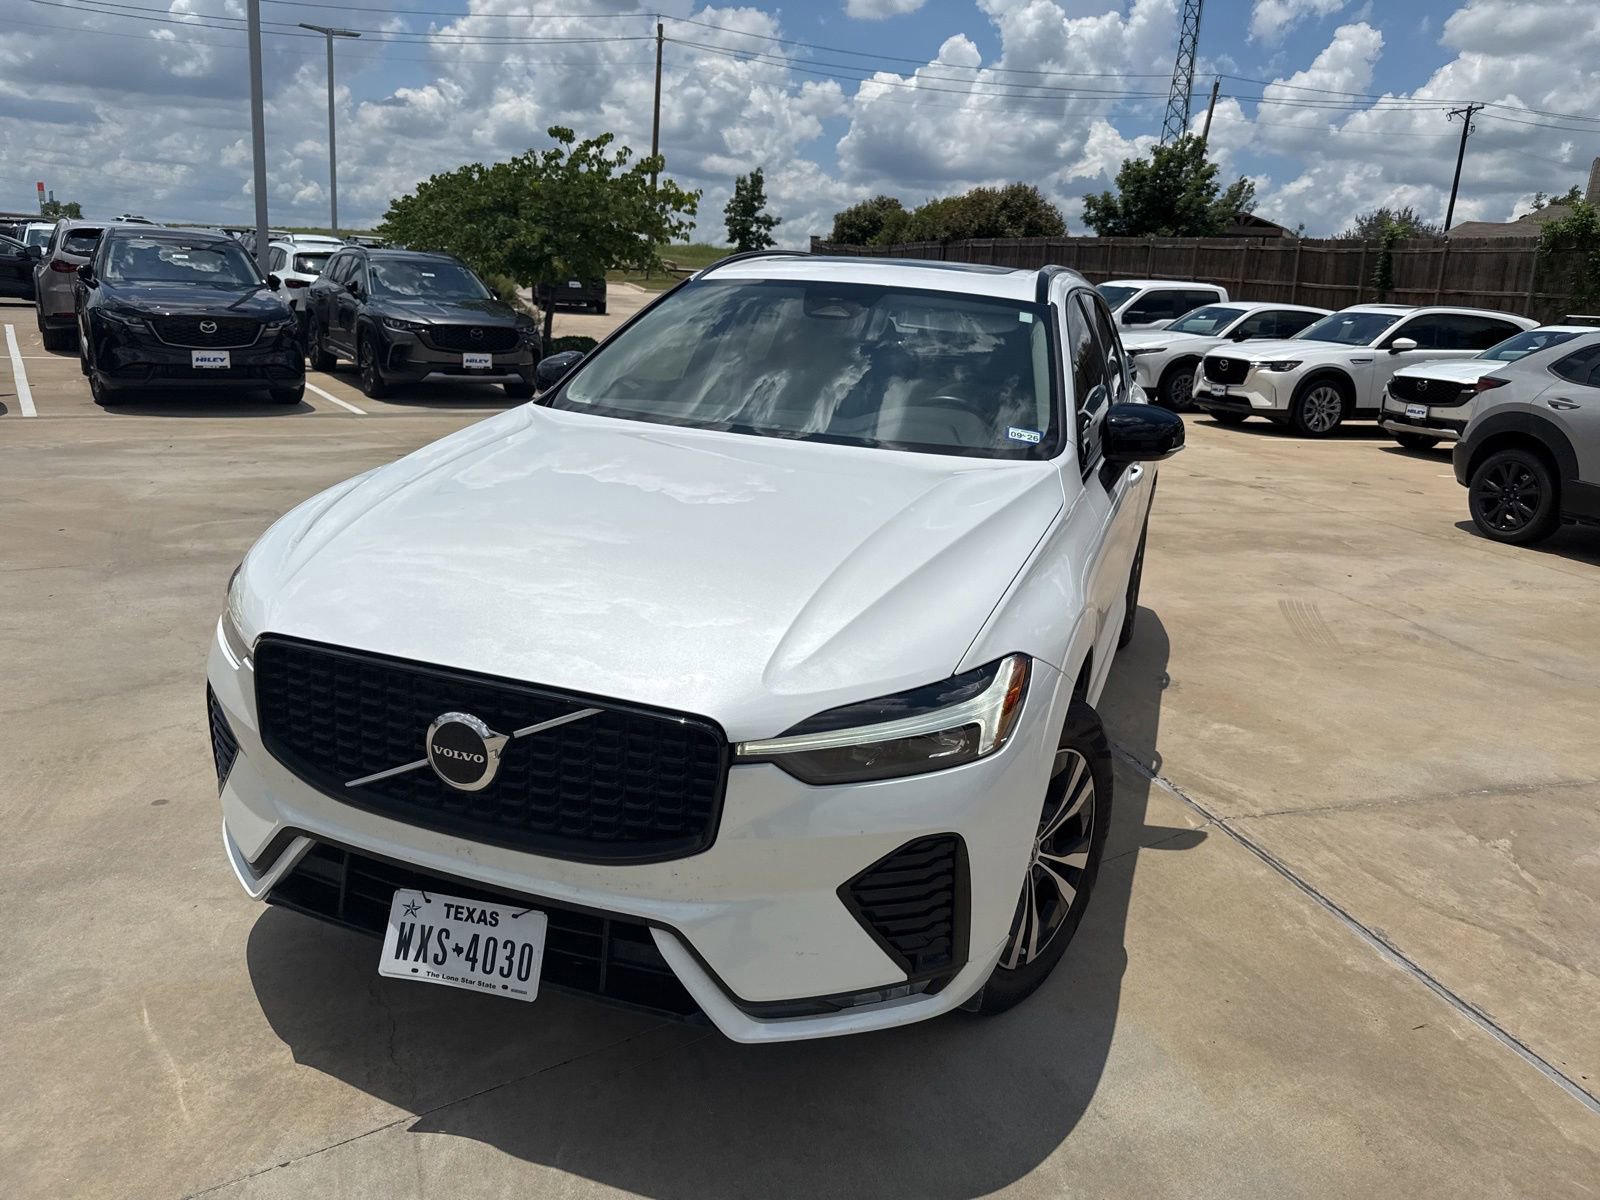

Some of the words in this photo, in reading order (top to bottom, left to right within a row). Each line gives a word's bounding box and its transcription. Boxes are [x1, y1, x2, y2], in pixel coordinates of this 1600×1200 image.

[432, 744, 485, 763] VOLVO
[443, 902, 500, 928] TEXAS
[394, 921, 451, 966] WXS
[464, 933, 534, 982] 4030
[426, 970, 440, 978] The
[441, 973, 459, 982] Lone
[460, 977, 476, 985] Star
[477, 981, 497, 990] State
